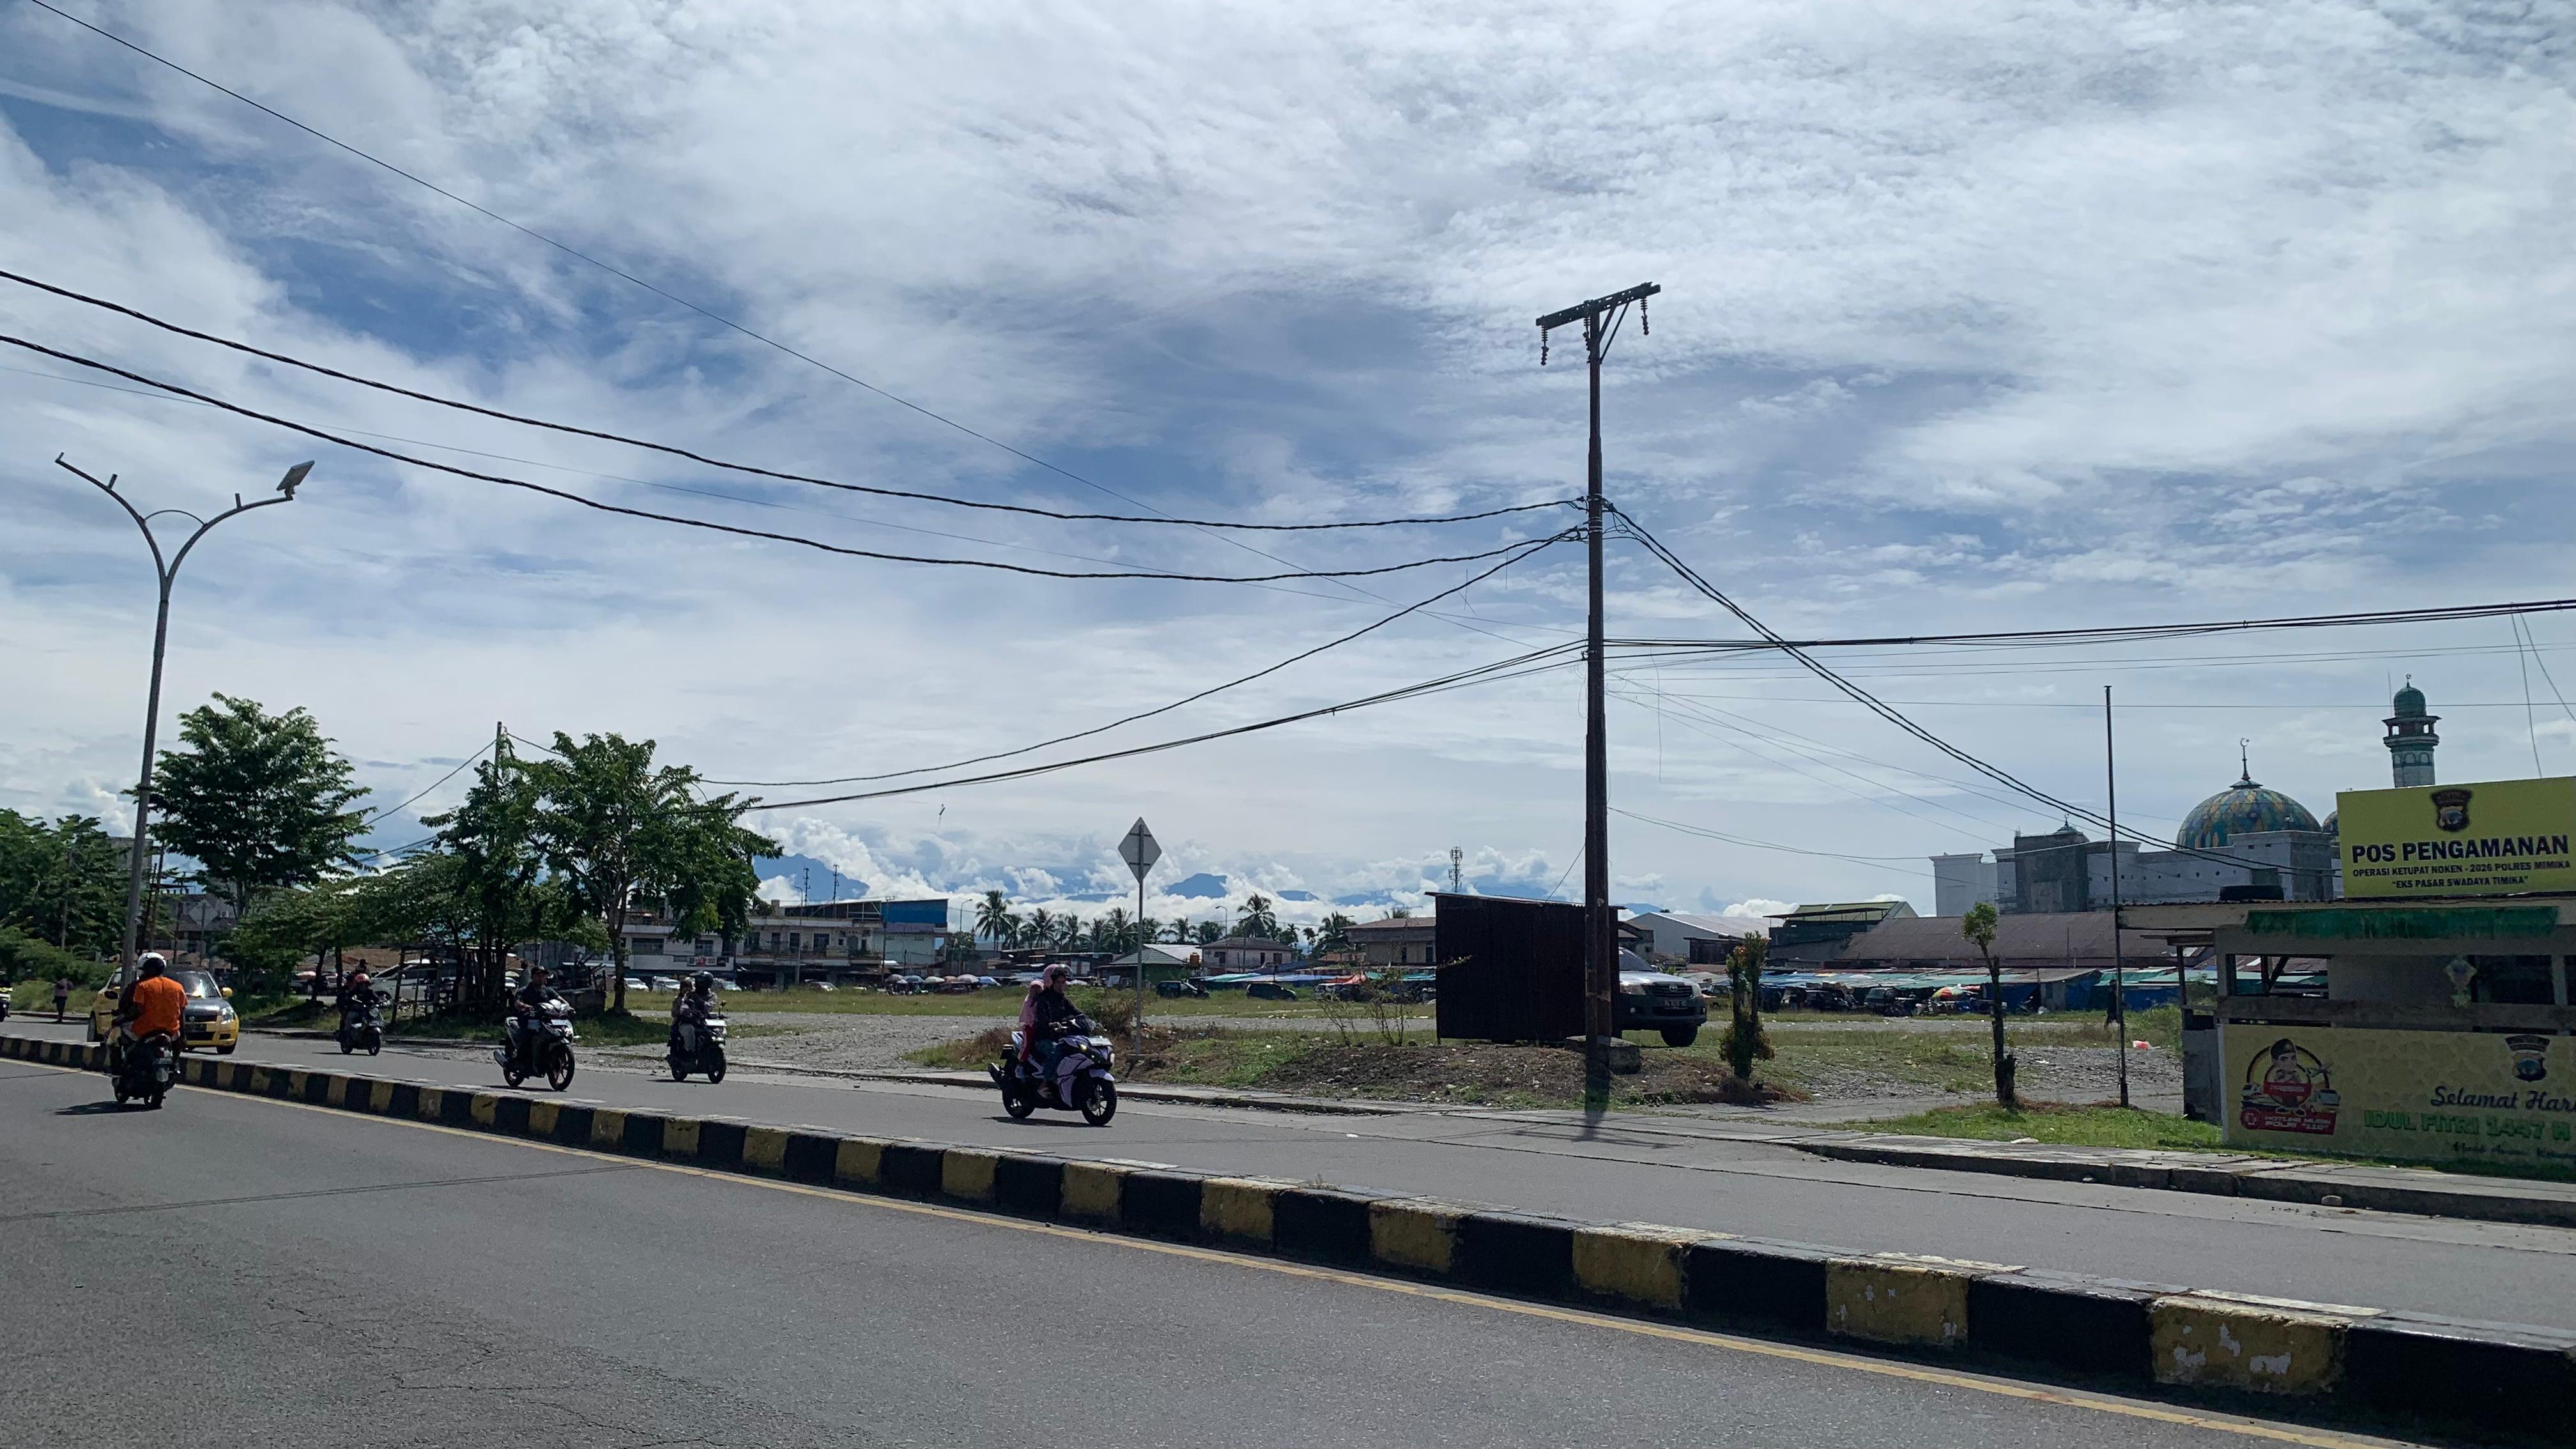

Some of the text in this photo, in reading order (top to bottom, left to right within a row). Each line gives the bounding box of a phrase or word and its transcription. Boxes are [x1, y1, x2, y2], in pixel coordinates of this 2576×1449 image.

[2352, 834, 2568, 862] POS PENGAMANAN
[2392, 866, 2428, 875] KETUPAT
[2432, 864, 2462, 873] NOKEN
[2470, 864, 2492, 872] 2026
[2495, 862, 2531, 871] POLRES
[2534, 860, 2570, 870] MIMIKA
[2415, 878, 2444, 887] PASAR
[2447, 877, 2490, 886] SWADAYA
[2431, 1086, 2518, 1109] Selamat
[2364, 1110, 2416, 1130] IDUL
[2421, 1112, 2479, 1135] FITRI
[2486, 1116, 2545, 1139] 1447
